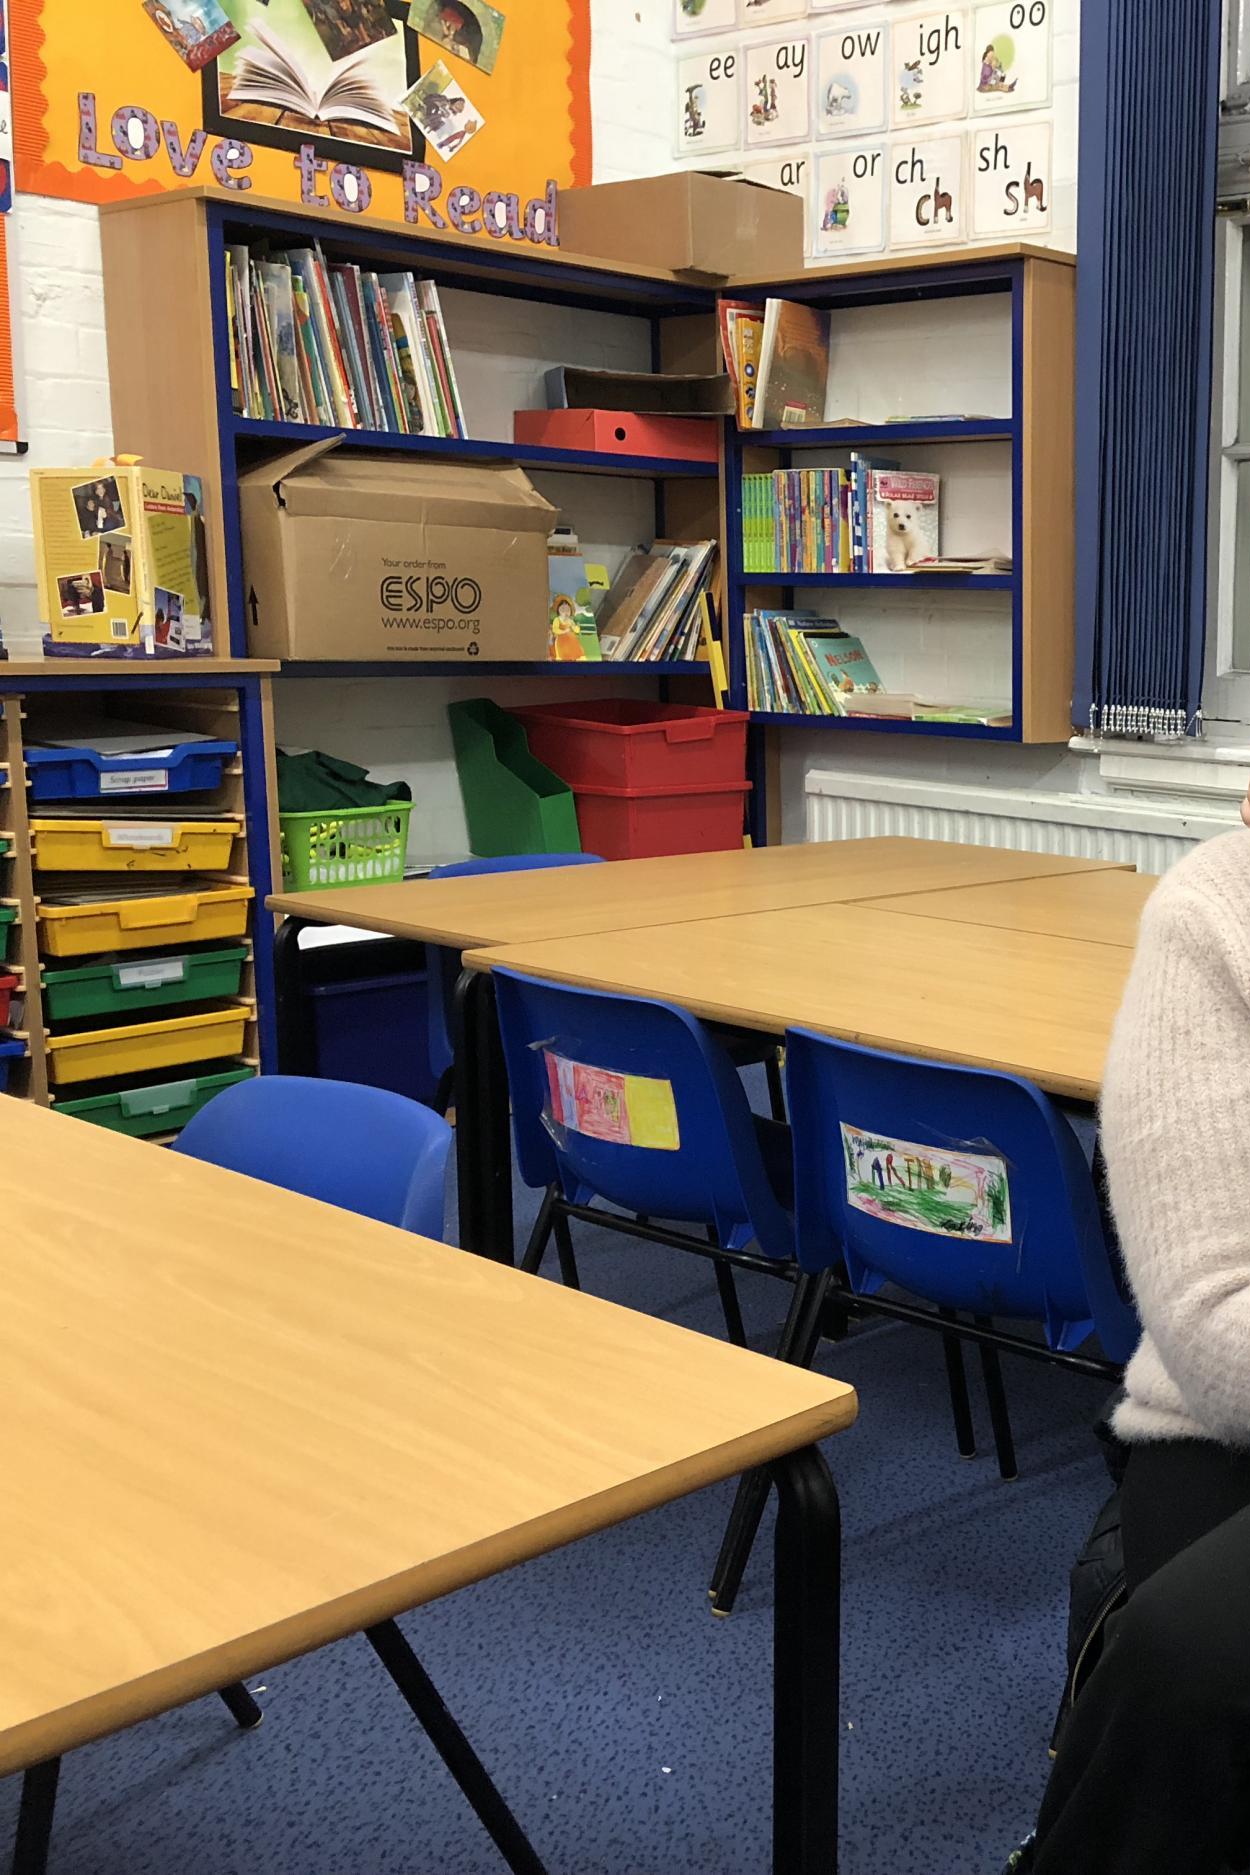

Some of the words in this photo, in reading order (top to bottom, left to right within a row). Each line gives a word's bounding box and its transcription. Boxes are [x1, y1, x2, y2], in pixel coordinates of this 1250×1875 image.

[1010, 1, 1046, 29] oo
[841, 31, 880, 60] ow
[919, 15, 961, 66] igh
[709, 54, 735, 80] ee
[776, 42, 806, 78] ay
[853, 151, 881, 178] or
[895, 147, 926, 185] ch
[977, 133, 1010, 172] sh
[77, 92, 253, 190] Love
[294, 144, 372, 213] to
[402, 160, 560, 247] Read
[780, 160, 806, 187] ar
[142, 482, 159, 498] Dear
[382, 558, 401, 568] Your
[403, 560, 427, 569] order
[427, 560, 447, 570] from
[380, 575, 482, 615] ESPO
[381, 616, 481, 635] www.espo.org
[110, 775, 131, 785] Scrap
[133, 775, 155, 785] paper
